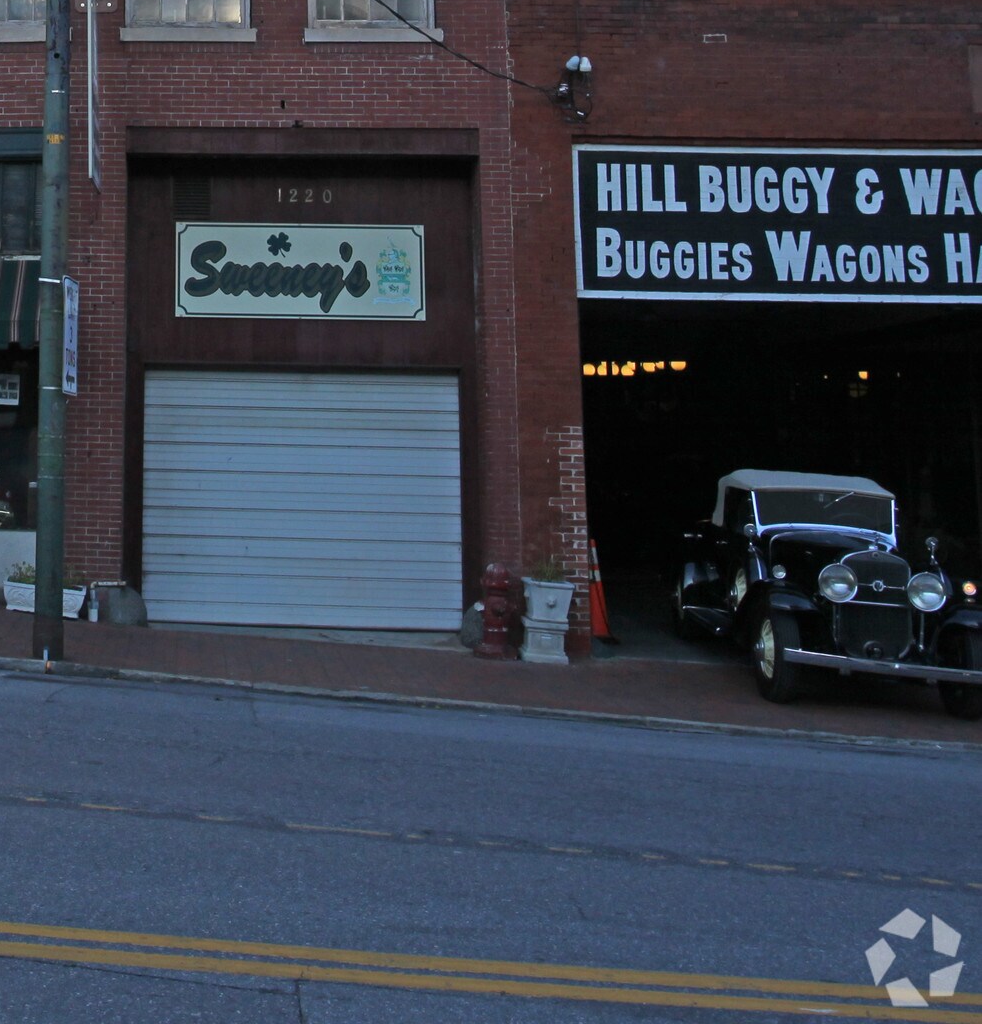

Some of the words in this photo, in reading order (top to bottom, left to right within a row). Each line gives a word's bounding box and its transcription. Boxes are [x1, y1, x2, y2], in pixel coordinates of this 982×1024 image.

[277, 187, 333, 204] 1220
[596, 162, 687, 212] HILL
[699, 164, 835, 215] BUGGY
[854, 167, 884, 216] &
[184, 240, 371, 314] Sweeney's
[943, 232, 982, 284] H
